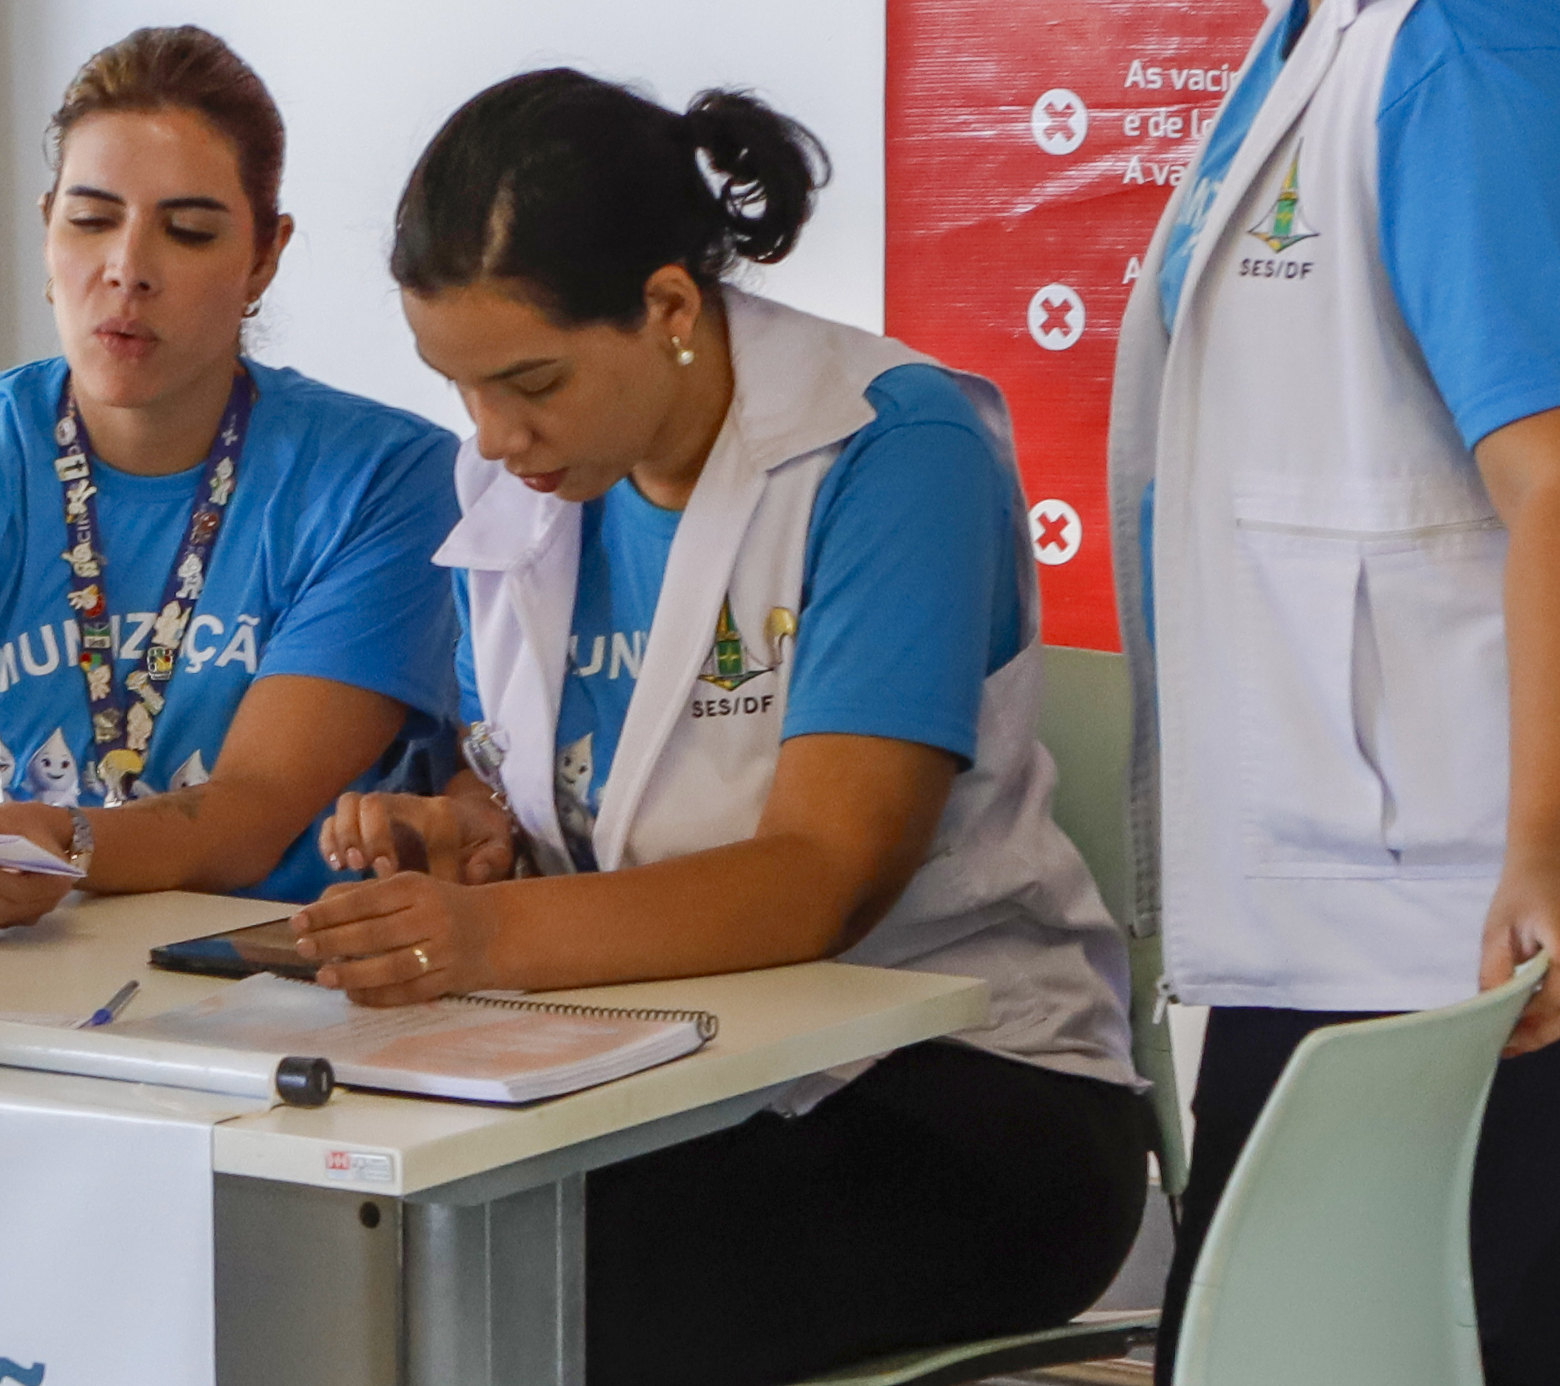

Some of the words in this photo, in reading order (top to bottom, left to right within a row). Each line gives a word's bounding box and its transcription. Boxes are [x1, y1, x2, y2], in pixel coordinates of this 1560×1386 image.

[1124, 59, 1163, 89] As
[1124, 111, 1141, 137] e
[1148, 107, 1184, 137] de
[1123, 155, 1146, 185] A
[1239, 258, 1314, 280] SES/DF
[691, 694, 774, 719] SES/DF
